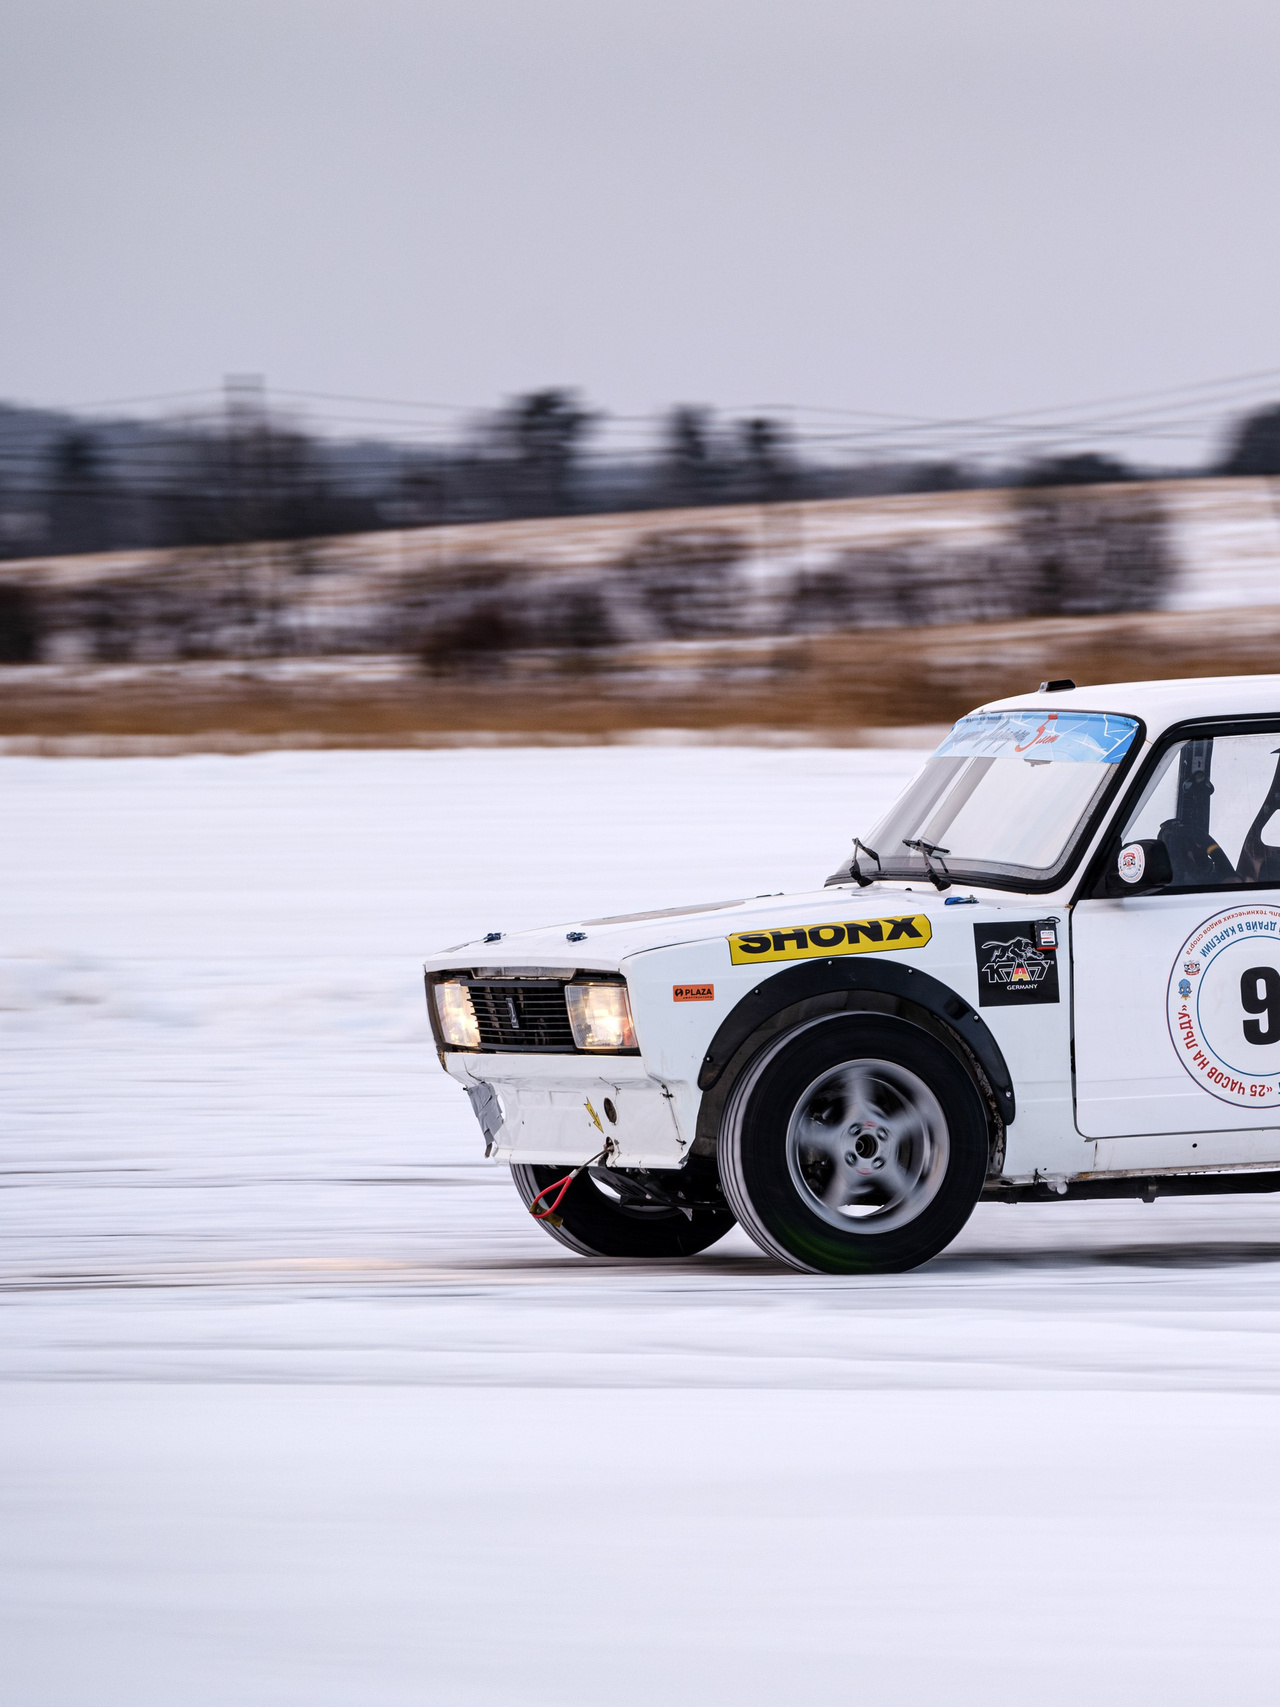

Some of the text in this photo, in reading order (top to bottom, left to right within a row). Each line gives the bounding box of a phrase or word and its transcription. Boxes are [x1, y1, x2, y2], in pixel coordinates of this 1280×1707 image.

[1223, 909, 1267, 922] технических
[738, 917, 923, 954] SHONX
[1203, 919, 1222, 935] видов
[1237, 924, 1244, 932] В
[1245, 921, 1277, 932] ДРАЙВ
[1186, 933, 1204, 955] спорта
[1200, 926, 1237, 957] КАРЕЛИИ
[685, 988, 712, 996] PLAZA
[1192, 1050, 1210, 1070] НА
[1207, 1066, 1245, 1095] ЧАСОВ
